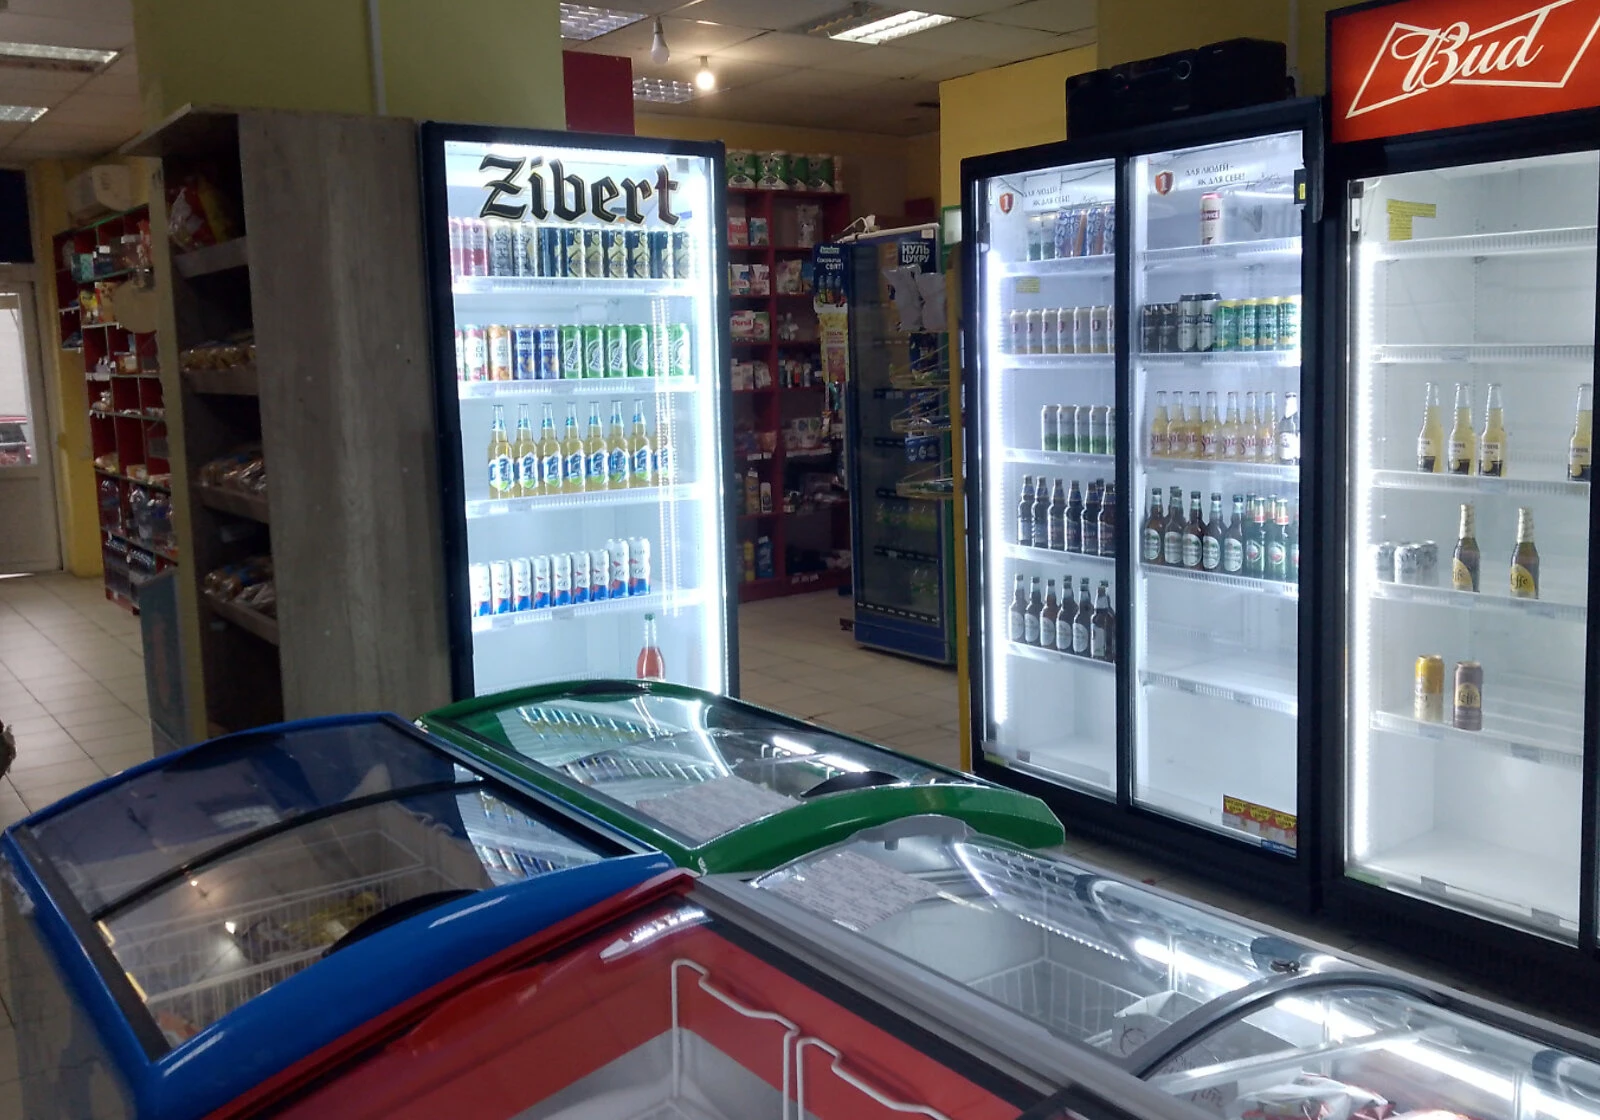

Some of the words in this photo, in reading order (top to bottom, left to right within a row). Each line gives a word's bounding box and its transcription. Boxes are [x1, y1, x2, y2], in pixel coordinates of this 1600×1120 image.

[1391, 10, 1544, 93] Bud
[478, 153, 681, 226] Zibert
[902, 244, 930, 255] НУЛЬ
[902, 254, 930, 264] ЦУКРУ
